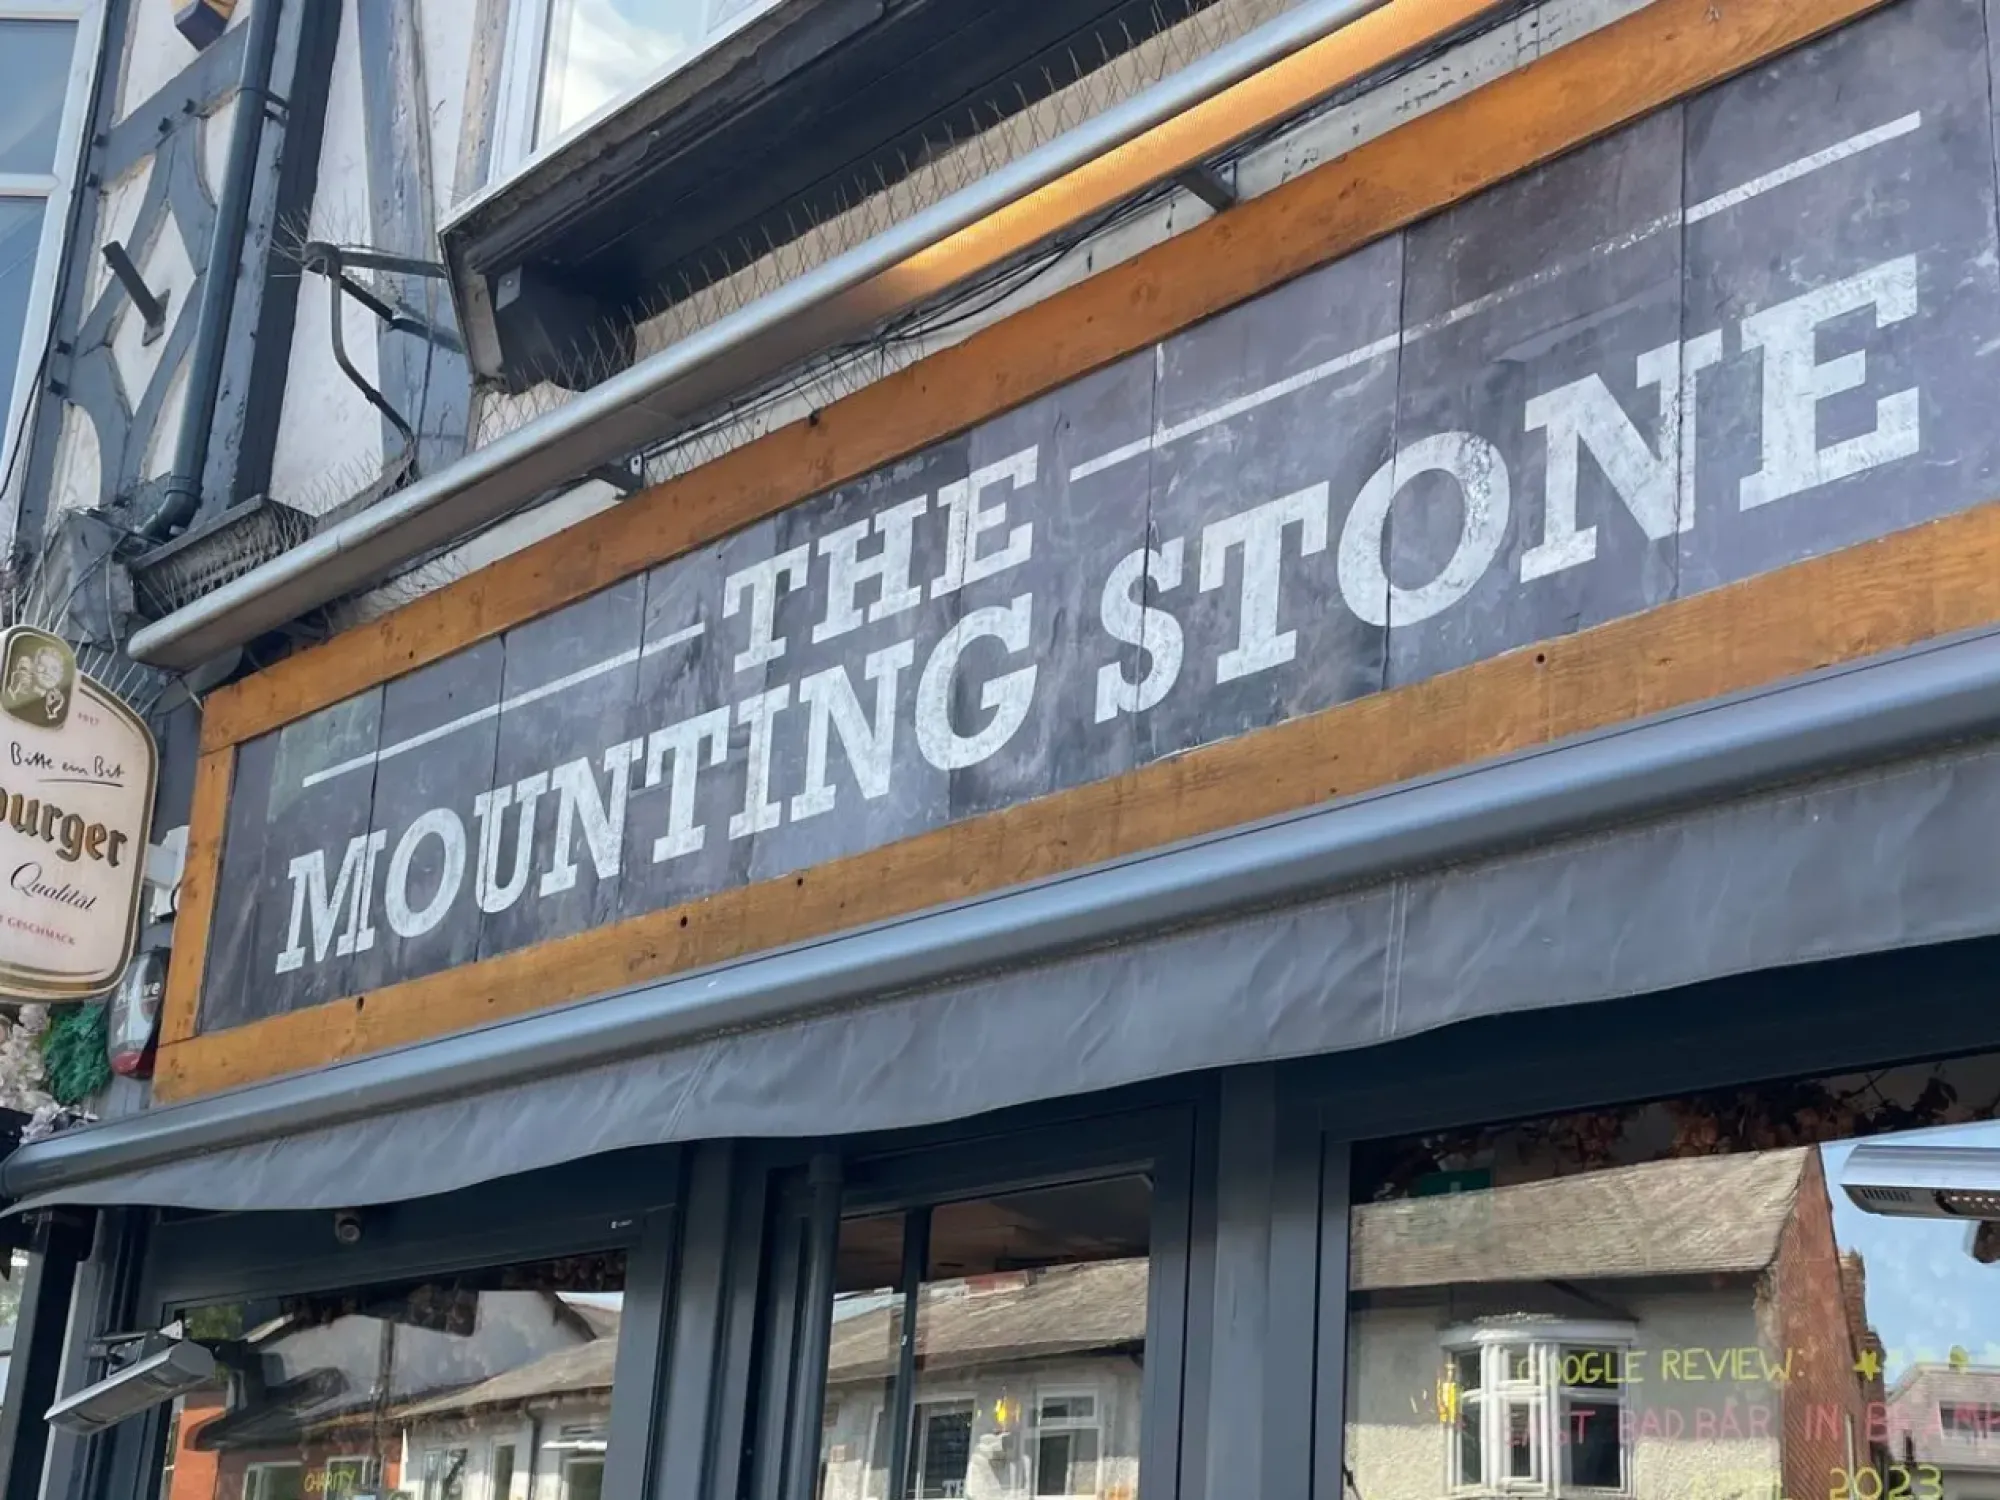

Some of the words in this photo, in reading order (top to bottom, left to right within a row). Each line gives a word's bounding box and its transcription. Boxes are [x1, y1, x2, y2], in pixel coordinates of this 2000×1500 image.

[723, 445, 1039, 673] THE
[275, 592, 1039, 975] MOUNTING
[1094, 254, 1920, 725] STONE
[10, 741, 54, 769] Bitte
[94, 755, 125, 778] Bit
[0, 786, 128, 868] urger
[10, 861, 98, 913] Qualität
[1618, 1405, 1685, 1445] BAD
[1805, 1402, 1842, 1442] IN
[303, 1468, 357, 1494] CHARITY
[1828, 1464, 1945, 1500] 2023
